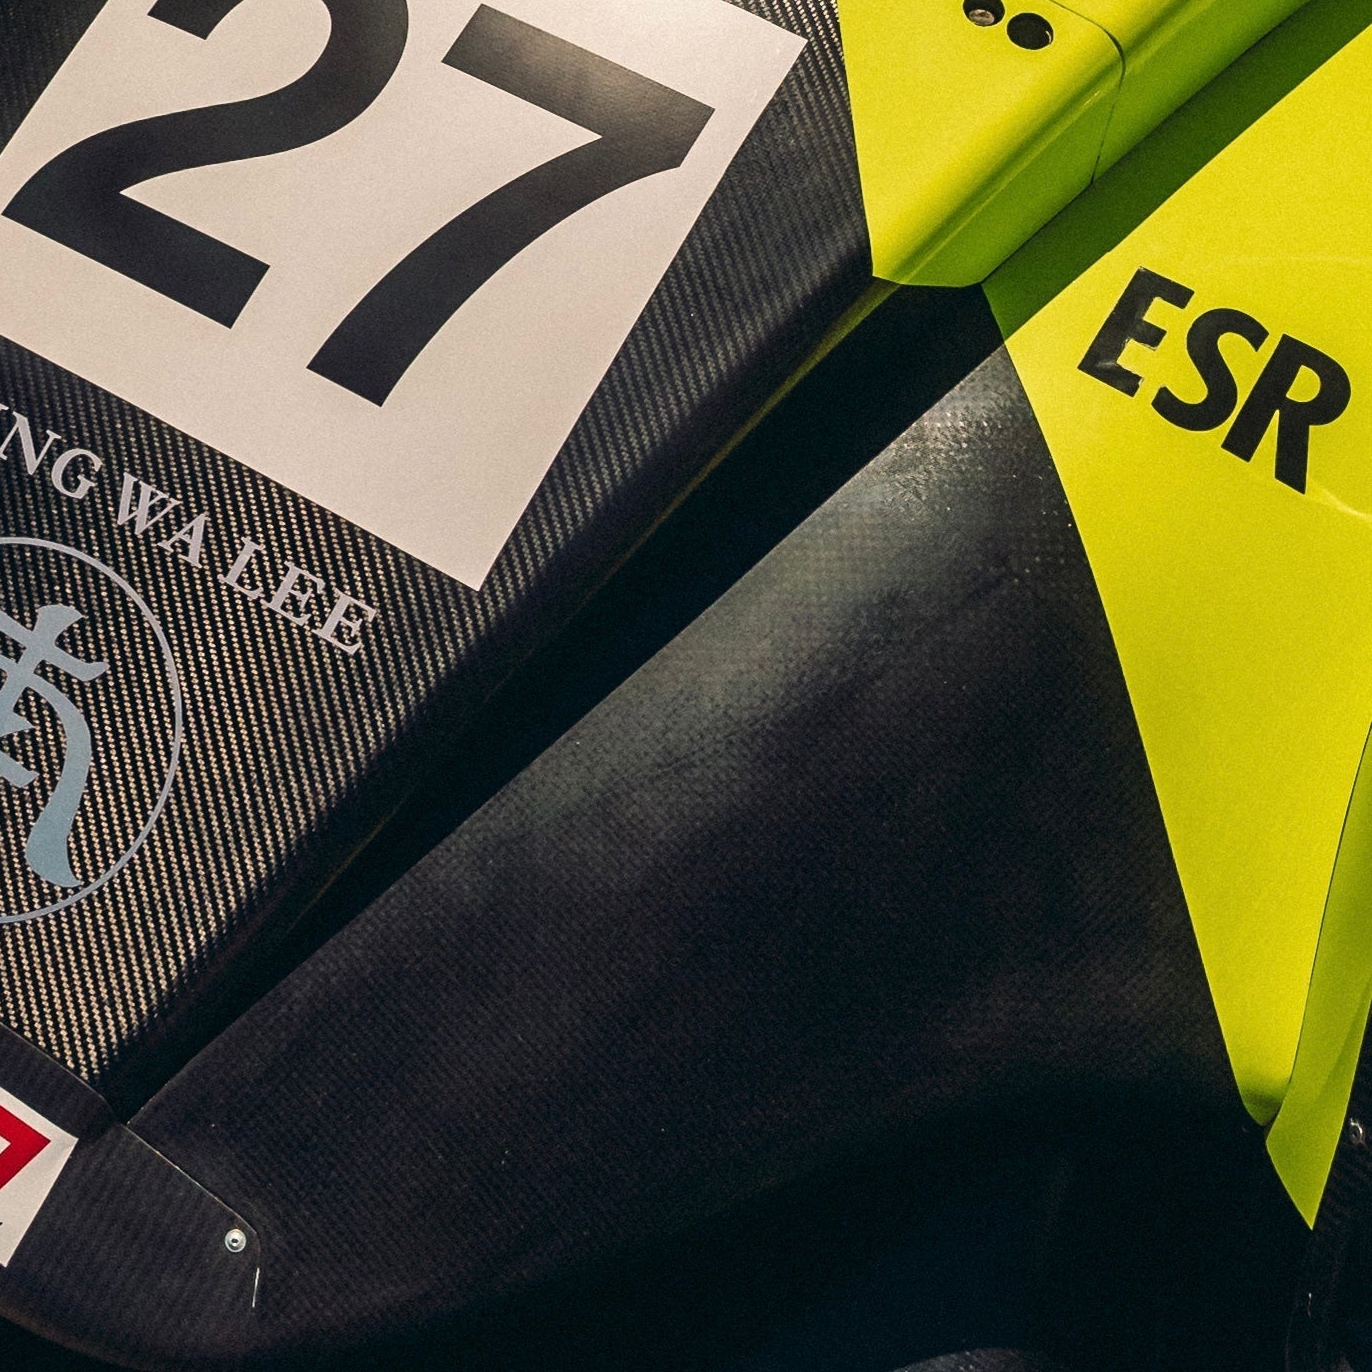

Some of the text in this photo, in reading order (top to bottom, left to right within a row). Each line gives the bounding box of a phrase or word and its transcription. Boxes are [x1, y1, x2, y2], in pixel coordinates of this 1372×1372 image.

[1077, 265, 1352, 495] ESR
[115, 472, 208, 568] WA
[217, 536, 379, 657] LEE
